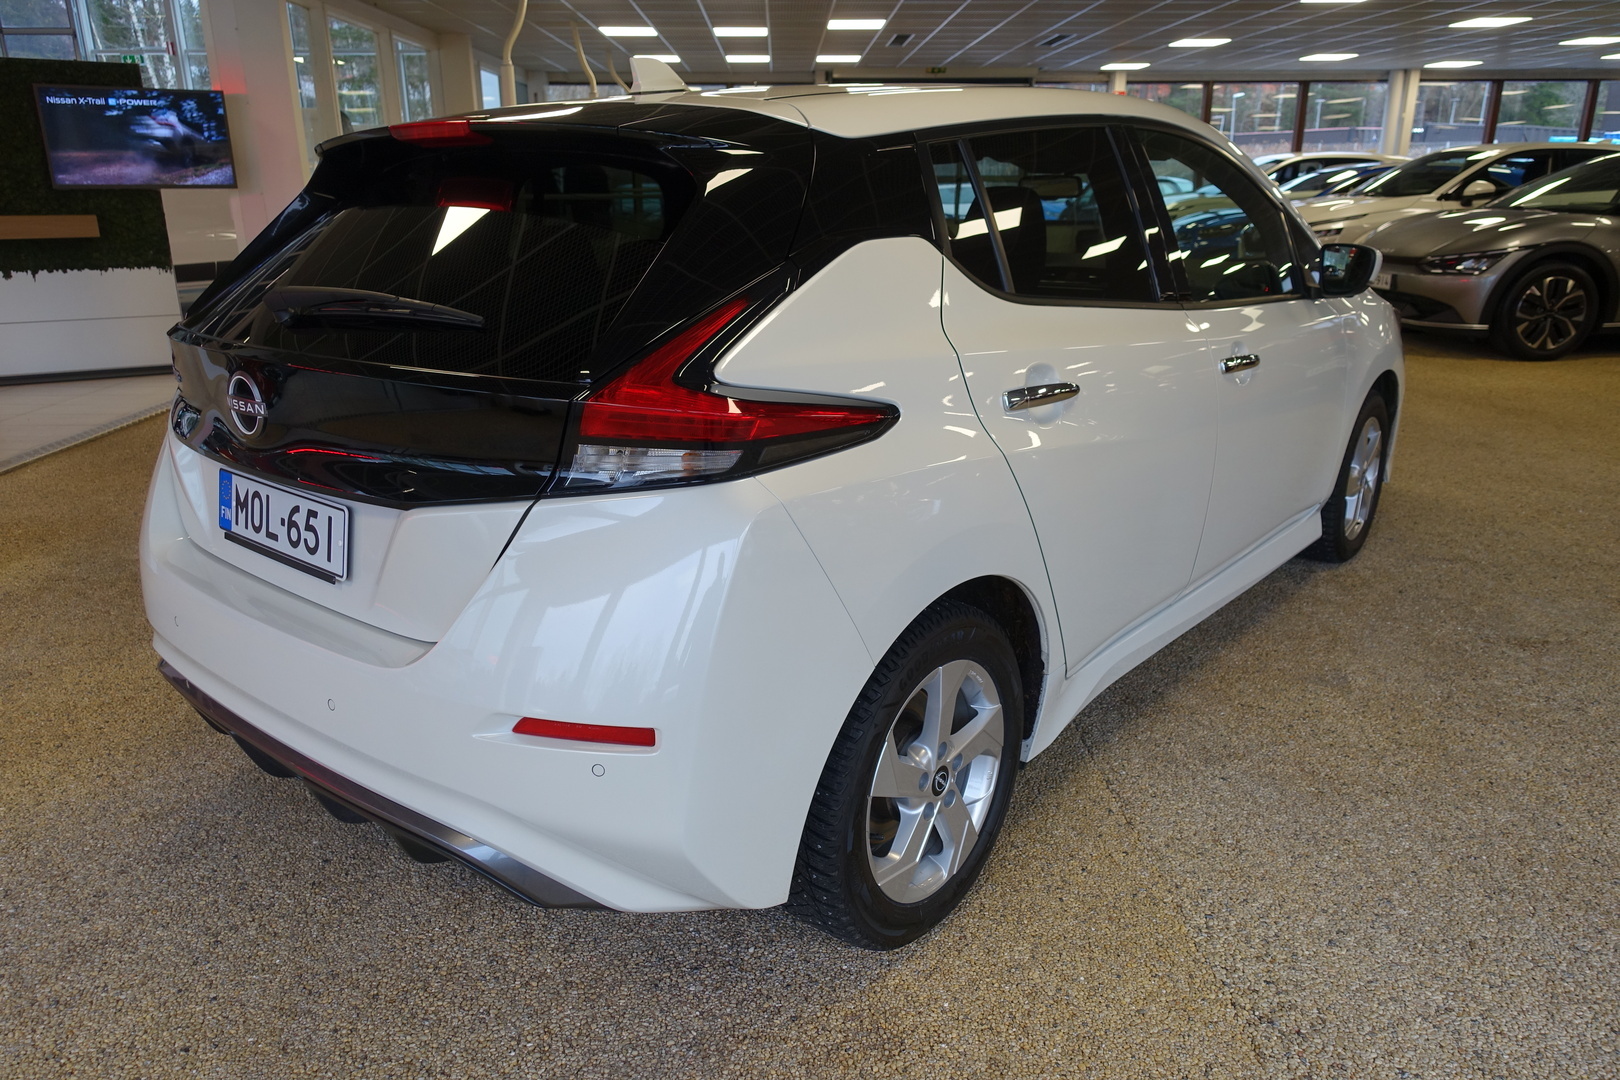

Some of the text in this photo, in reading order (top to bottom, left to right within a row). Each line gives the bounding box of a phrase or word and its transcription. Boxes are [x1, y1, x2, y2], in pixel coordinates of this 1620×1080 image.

[46, 96, 77, 105] Nissan
[79, 97, 105, 105] X-Trail
[221, 505, 232, 521] FIN
[235, 483, 333, 563] MOL-651
